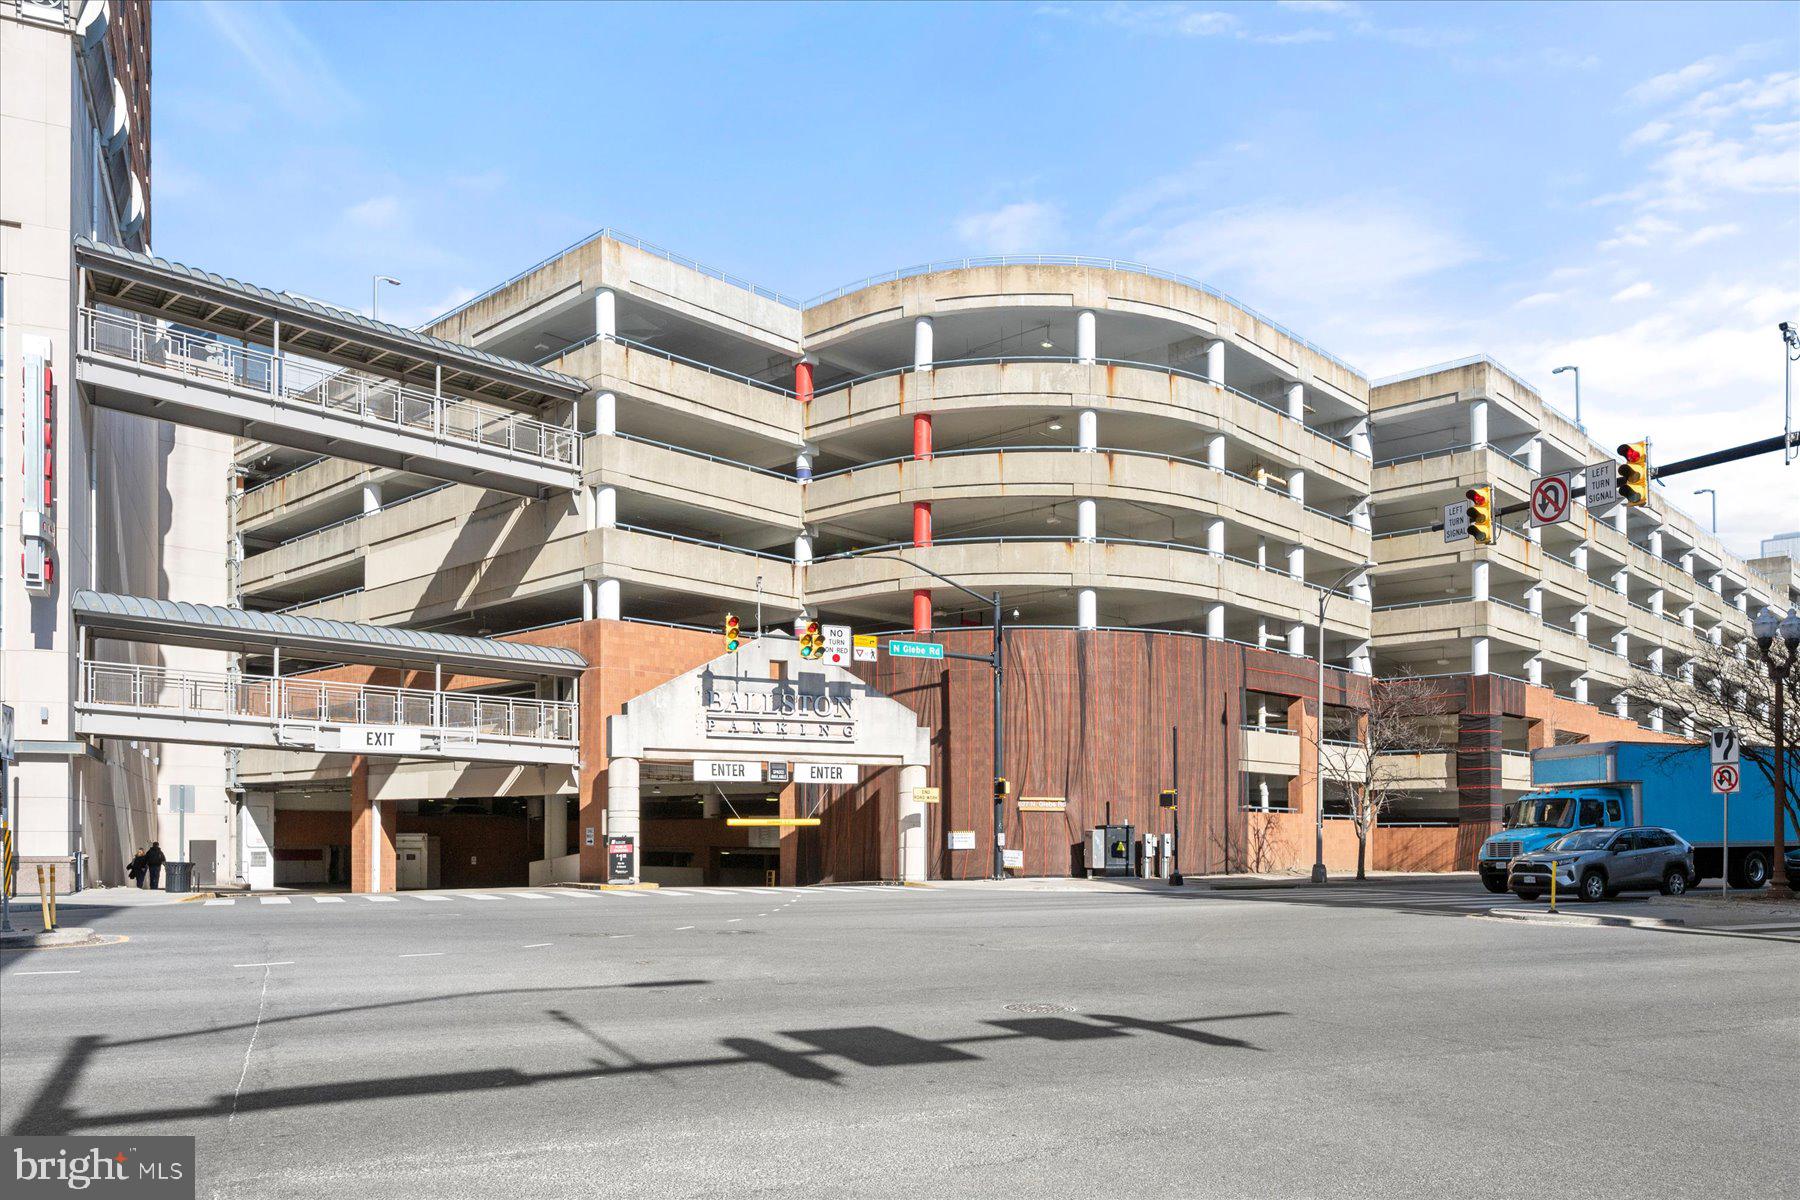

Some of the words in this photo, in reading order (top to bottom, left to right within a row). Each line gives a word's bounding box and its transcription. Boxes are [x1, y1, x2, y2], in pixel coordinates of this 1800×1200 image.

[1592, 466, 1609, 478] LEFT
[1592, 479, 1610, 490] TURN
[1588, 490, 1614, 503] SIGNAL
[1449, 505, 1463, 516] LEFT
[1449, 517, 1464, 526] TURN
[1446, 527, 1467, 539] SIGNAL
[830, 629, 843, 638] NO
[893, 644, 900, 653] N
[902, 644, 926, 655] Glebe
[929, 646, 941, 656] Rd
[706, 690, 854, 719] BALLSTON
[706, 719, 853, 738] PARKING
[366, 731, 395, 747] EXIT
[711, 763, 745, 777] ENTER
[810, 766, 843, 780] ENTER
